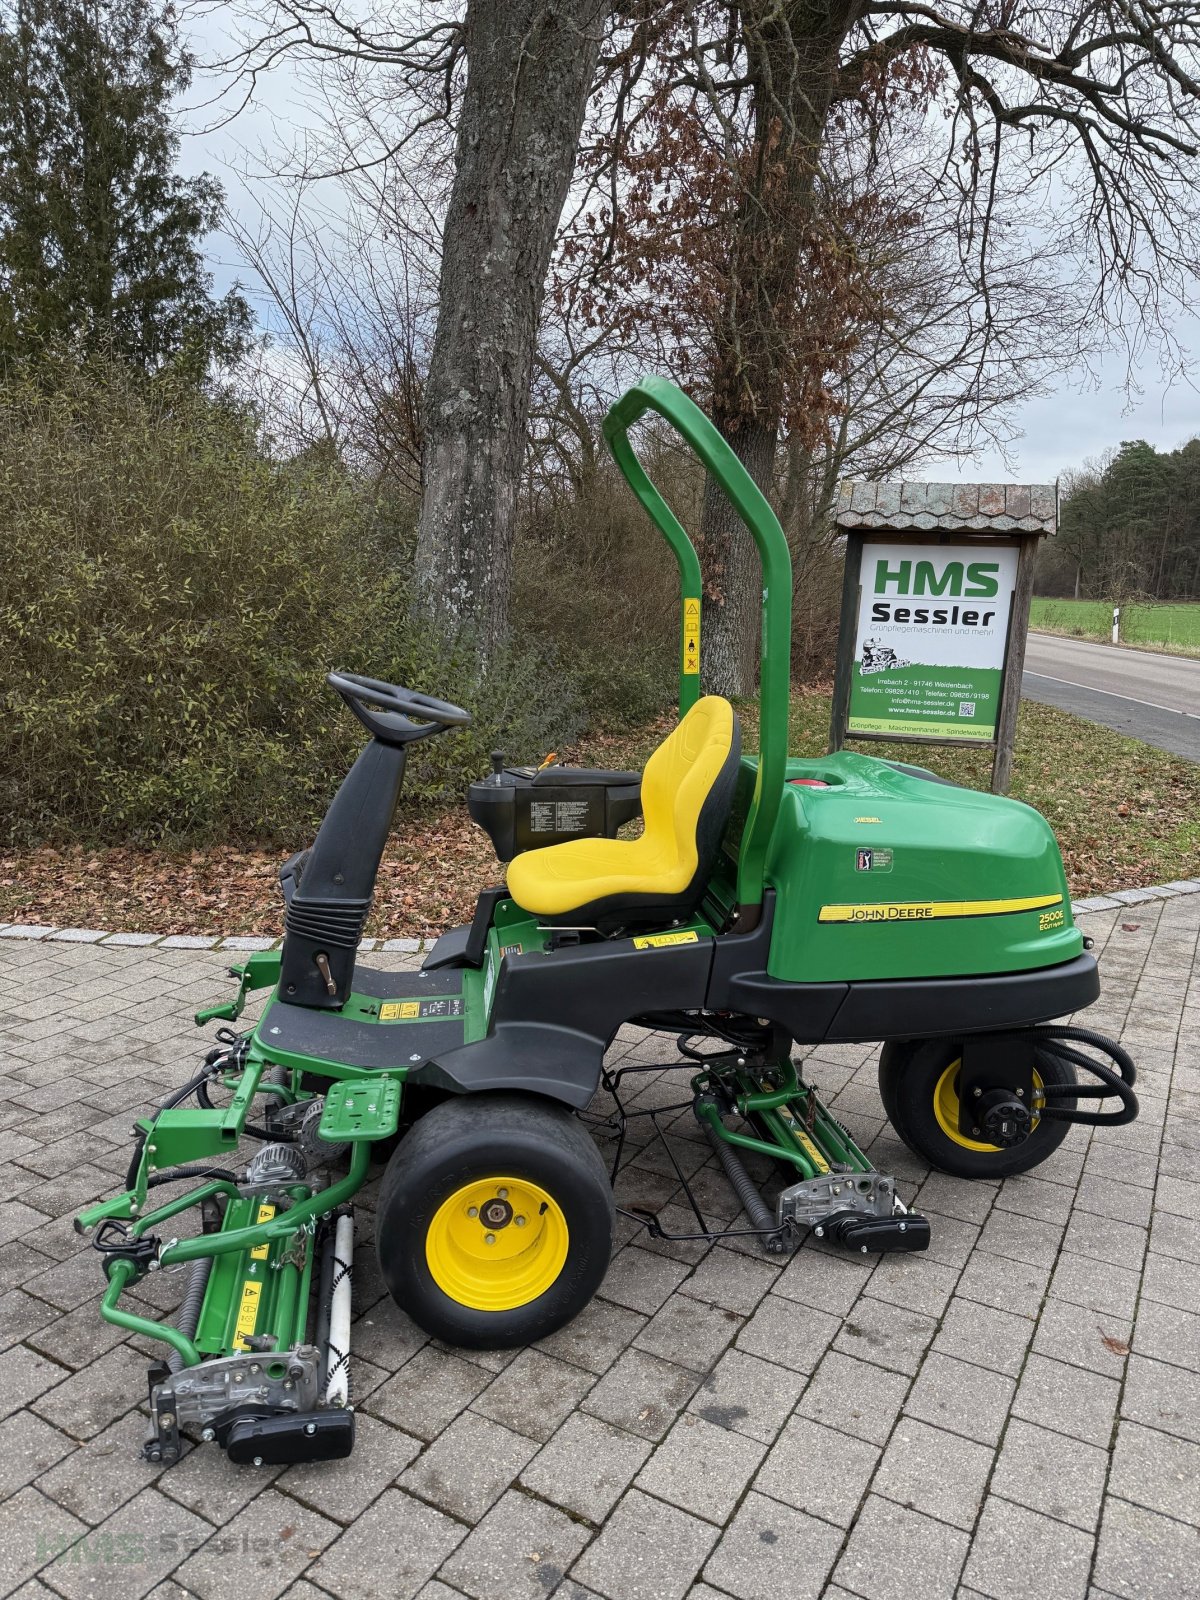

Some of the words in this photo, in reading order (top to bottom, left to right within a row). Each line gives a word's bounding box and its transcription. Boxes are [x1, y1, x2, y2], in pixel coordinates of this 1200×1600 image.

[874, 560, 999, 597] HMS
[871, 603, 996, 626] Sessler
[934, 681, 973, 689] Weidenbach
[860, 686, 883, 694] Telefon:
[925, 690, 948, 698] Telefax:
[891, 698, 955, 707] info@hms-sessler.de
[888, 707, 956, 716] www.hms-sessler.de
[850, 722, 882, 731] Grünpflege
[888, 724, 940, 734] Maschinenhandel
[847, 909, 885, 920] JOHN
[888, 907, 933, 918] DEERE
[1039, 911, 1064, 924] 2500E
